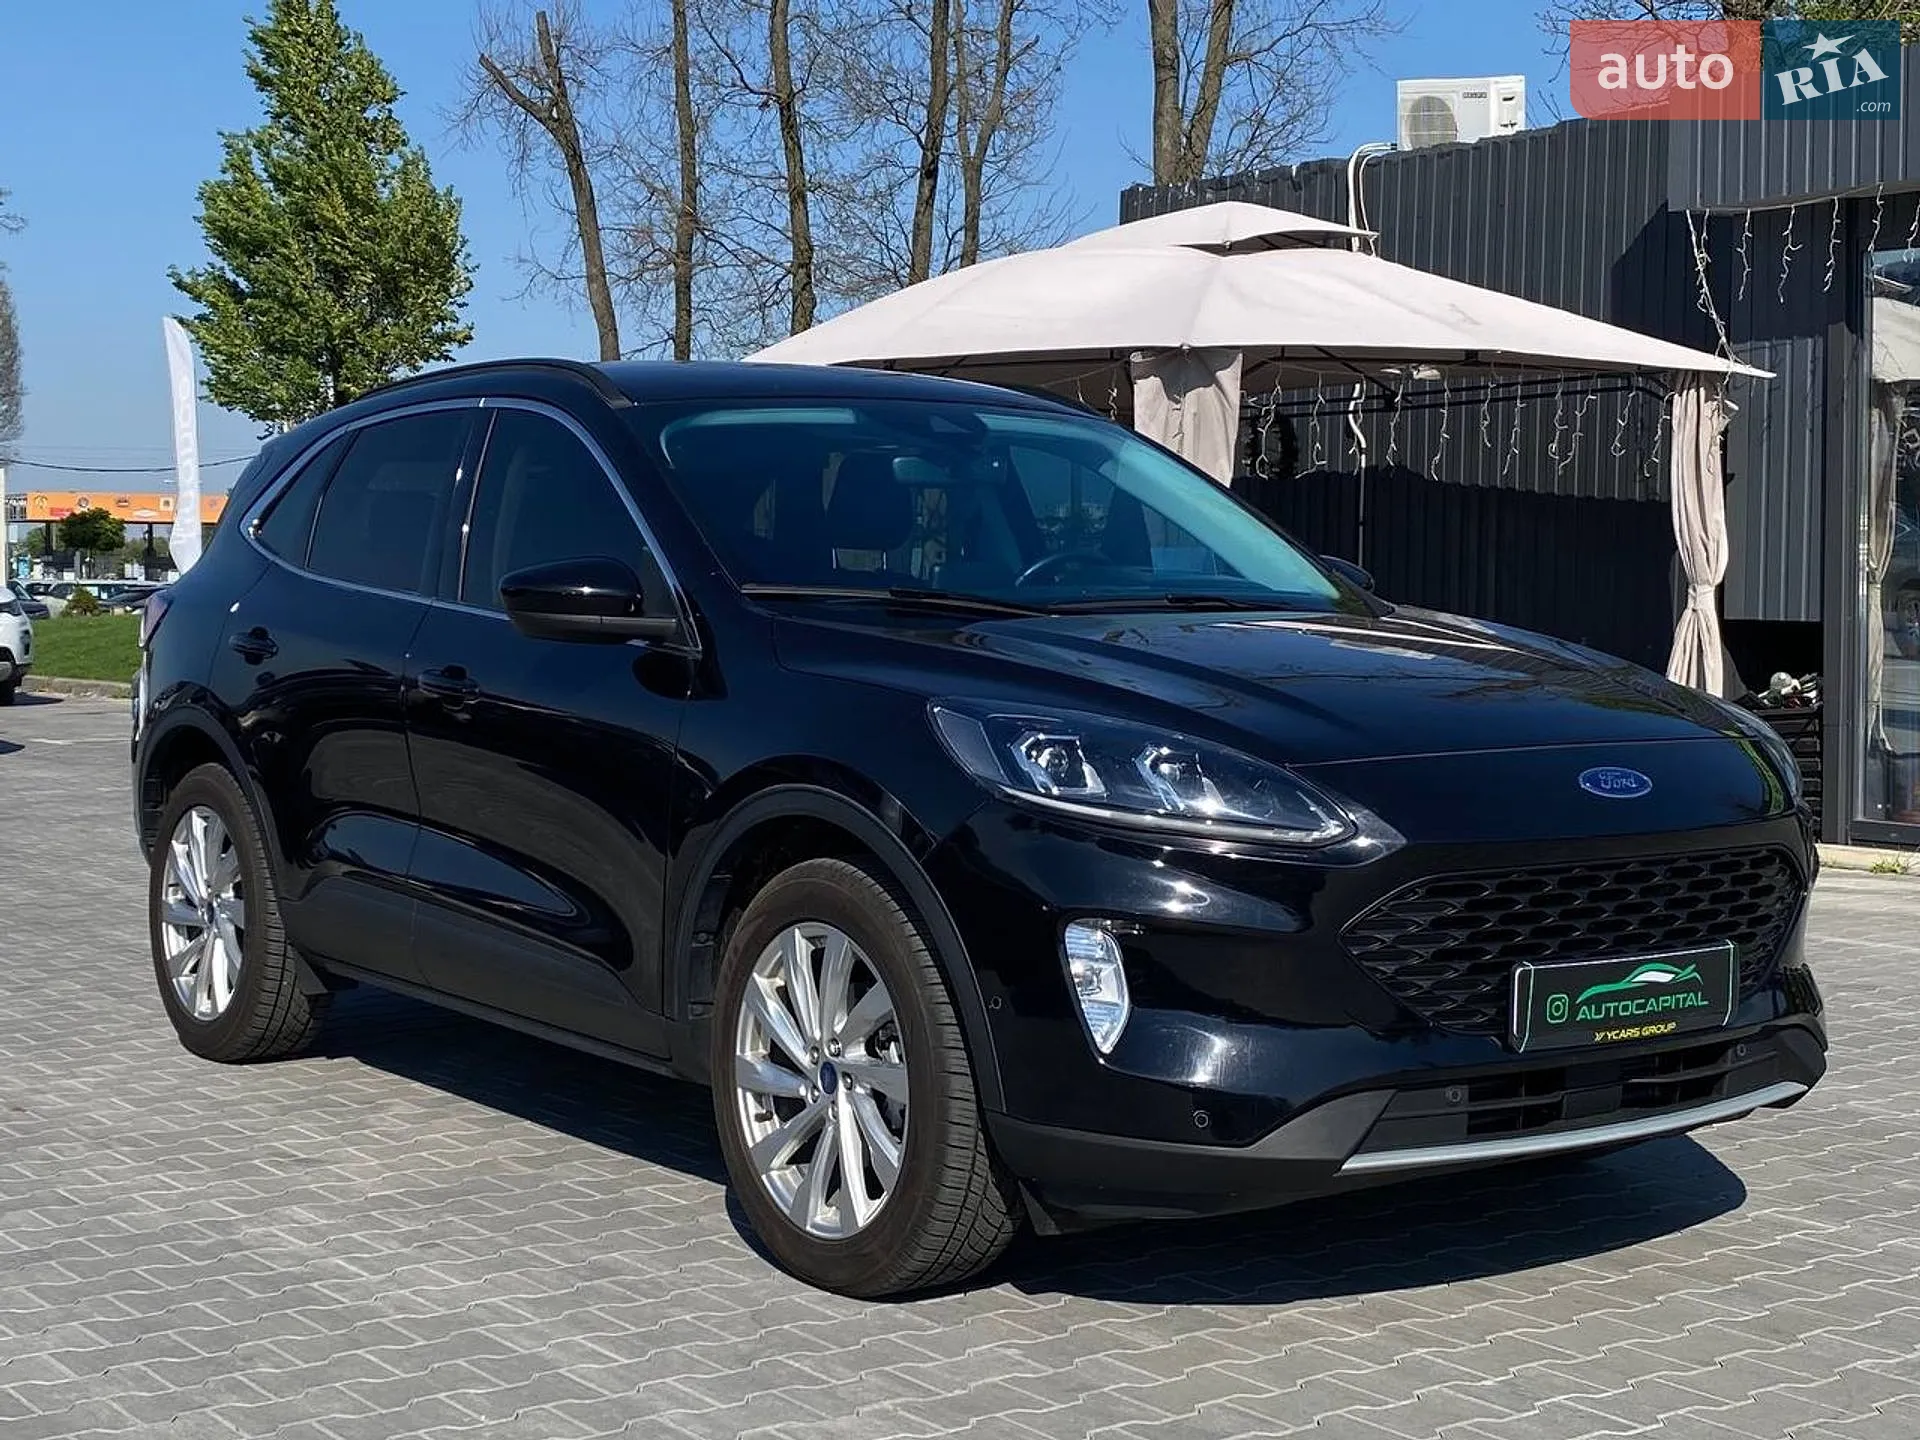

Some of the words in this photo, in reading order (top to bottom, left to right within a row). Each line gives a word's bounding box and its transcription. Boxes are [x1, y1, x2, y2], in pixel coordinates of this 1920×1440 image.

[1598, 771, 1638, 789] Ford
[1575, 991, 1709, 1021] AUTOCAPITAL
[1641, 1021, 1678, 1037] GROUP
